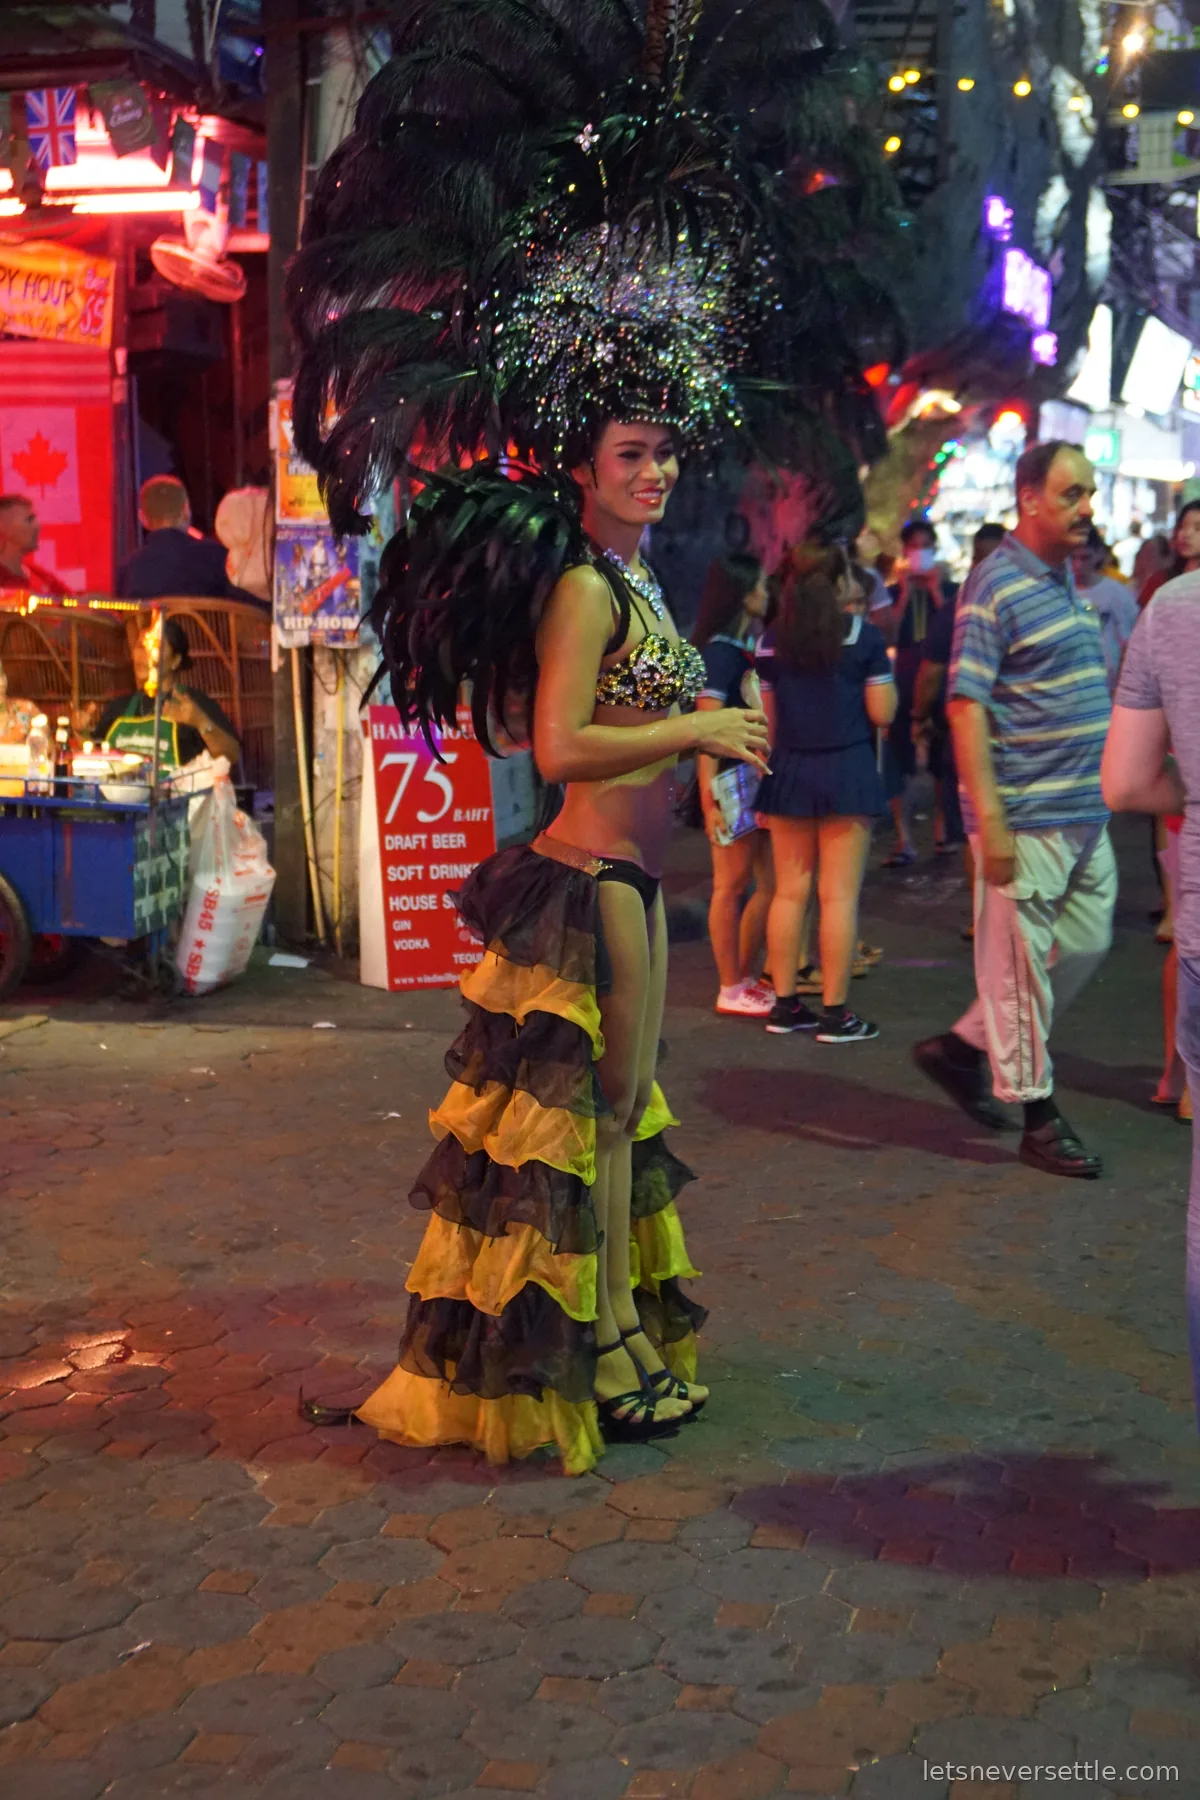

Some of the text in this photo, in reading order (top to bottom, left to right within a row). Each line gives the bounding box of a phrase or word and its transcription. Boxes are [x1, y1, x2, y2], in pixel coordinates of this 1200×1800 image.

[434, 720, 477, 740] HOU
[379, 752, 459, 825] 75
[452, 808, 491, 822] BAHT
[384, 833, 467, 851] DRAFT BEER
[387, 865, 424, 882] SOFT
[389, 894, 438, 912] HOUSE
[392, 920, 412, 931] GIN
[393, 938, 430, 951] VODKA
